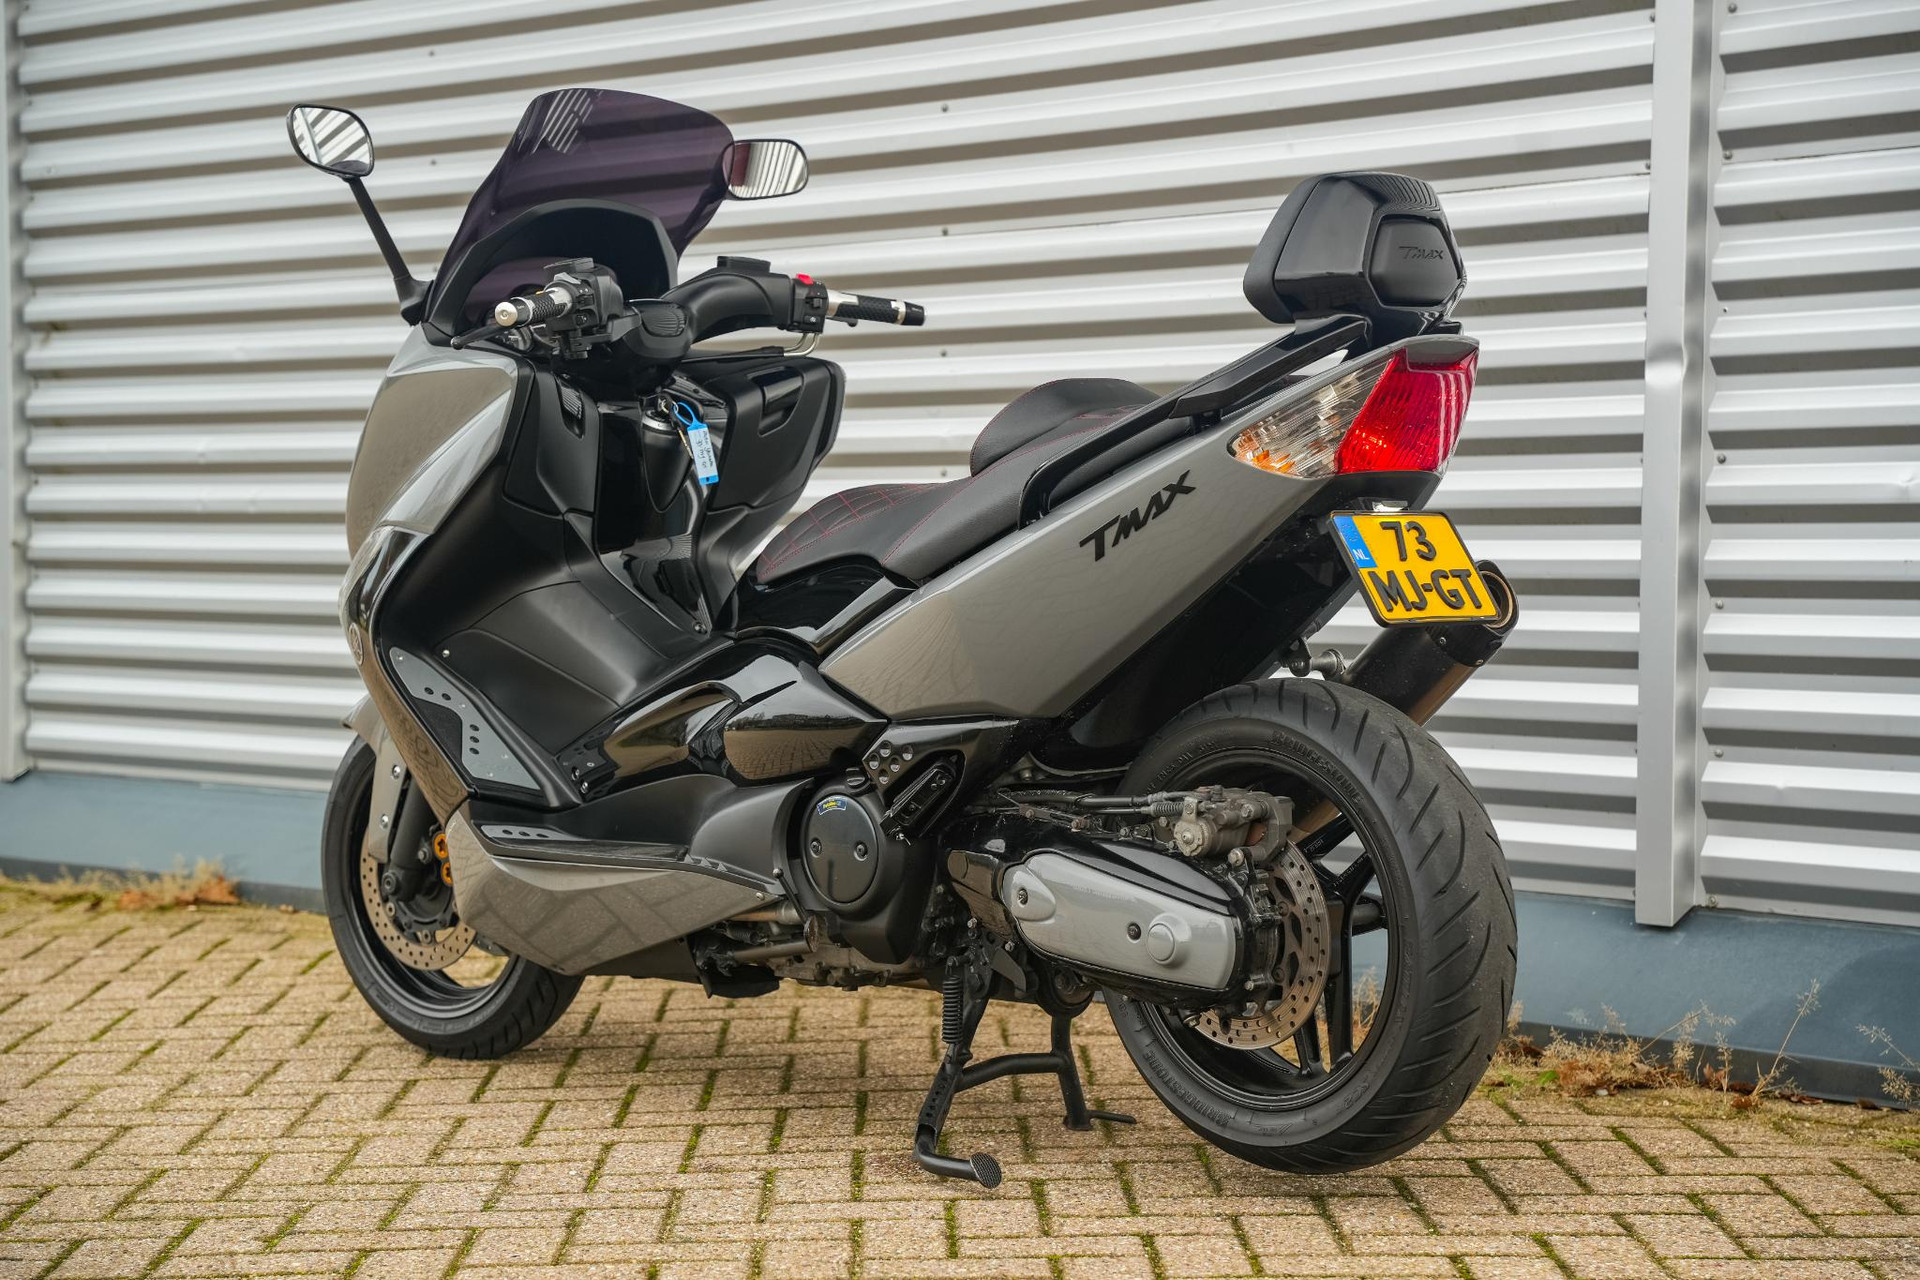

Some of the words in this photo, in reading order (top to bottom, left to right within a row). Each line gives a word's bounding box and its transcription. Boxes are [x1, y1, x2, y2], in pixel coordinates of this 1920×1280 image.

[1079, 470, 1196, 562] TMAX
[1352, 548, 1370, 560] NL
[1380, 521, 1437, 562] 73
[1368, 569, 1483, 613] MJ-GT
